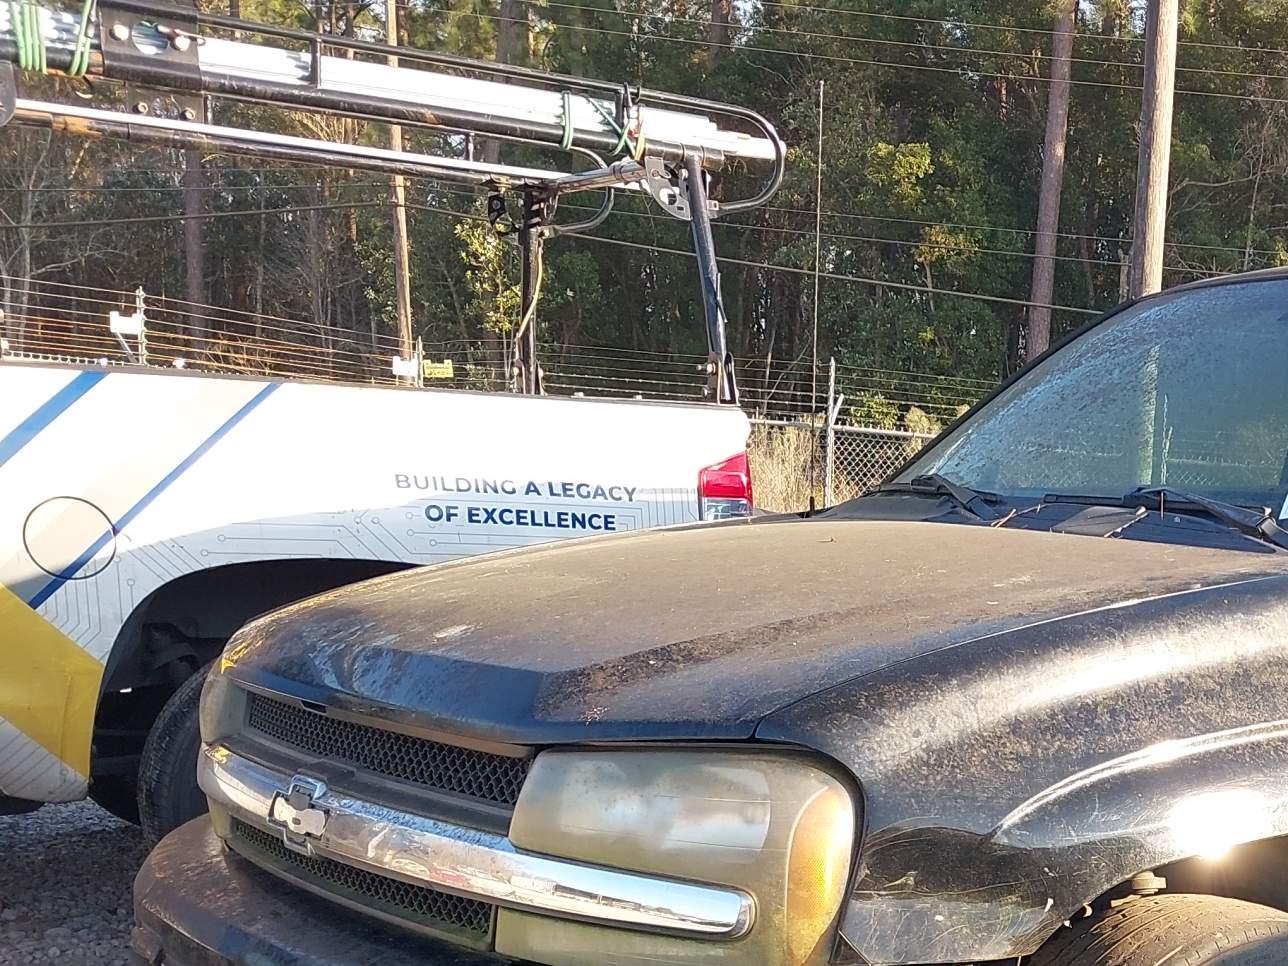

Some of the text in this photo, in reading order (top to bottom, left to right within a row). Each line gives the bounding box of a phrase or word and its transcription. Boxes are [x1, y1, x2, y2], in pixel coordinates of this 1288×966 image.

[395, 474, 637, 502] BUILDING A LEGACY
[425, 504, 617, 531] OF EXCELLENCE
